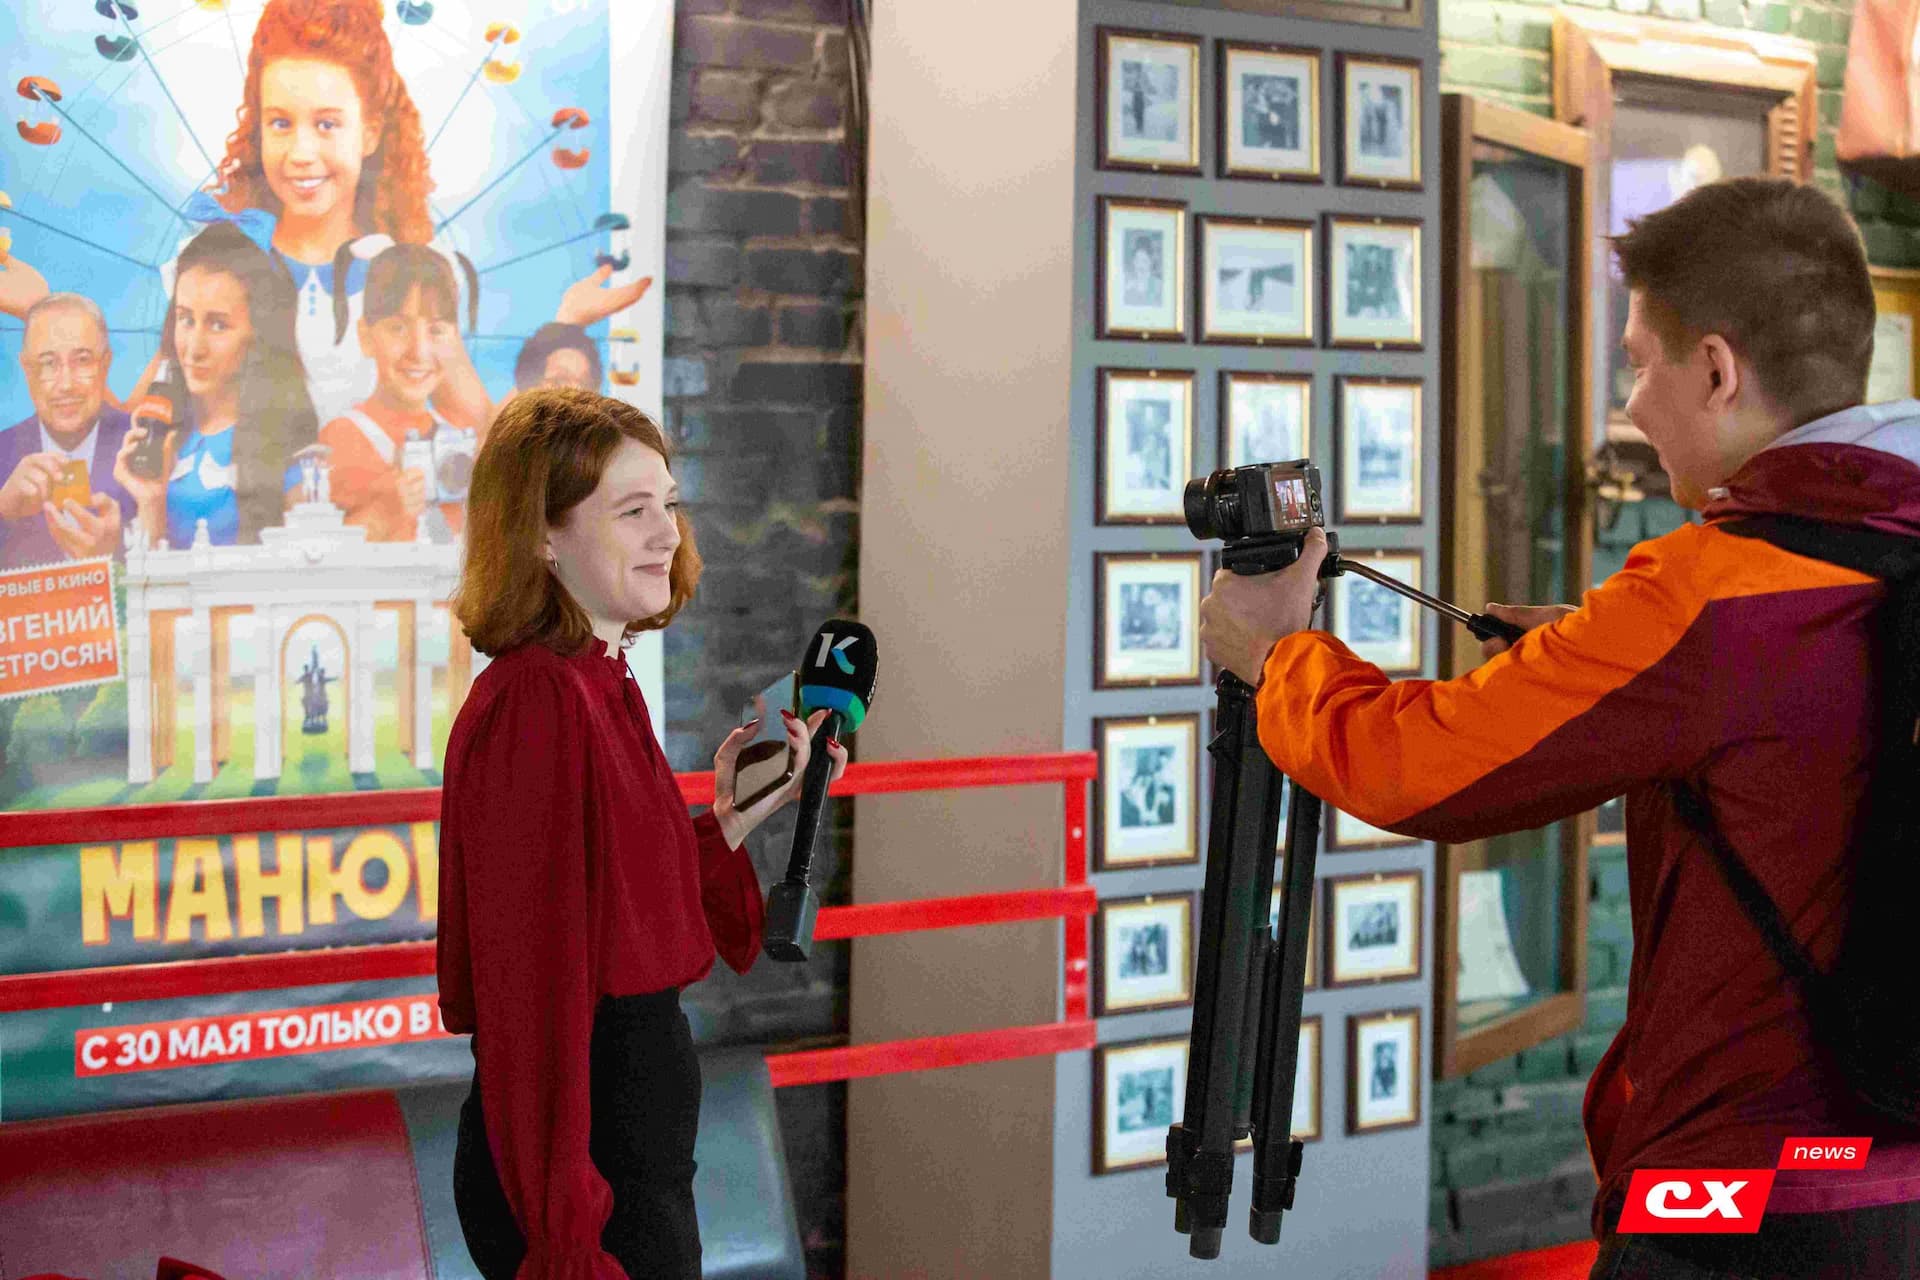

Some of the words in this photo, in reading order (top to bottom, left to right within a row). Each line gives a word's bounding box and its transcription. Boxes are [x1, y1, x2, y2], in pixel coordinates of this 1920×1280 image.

[45, 576, 55, 593] В
[58, 570, 106, 590] КИНО
[82, 1035, 108, 1069] С
[115, 1029, 160, 1064] 30
[168, 1020, 250, 1061] МАЯ
[258, 1005, 402, 1051] ТОЛЬКО
[409, 1002, 433, 1035] В
